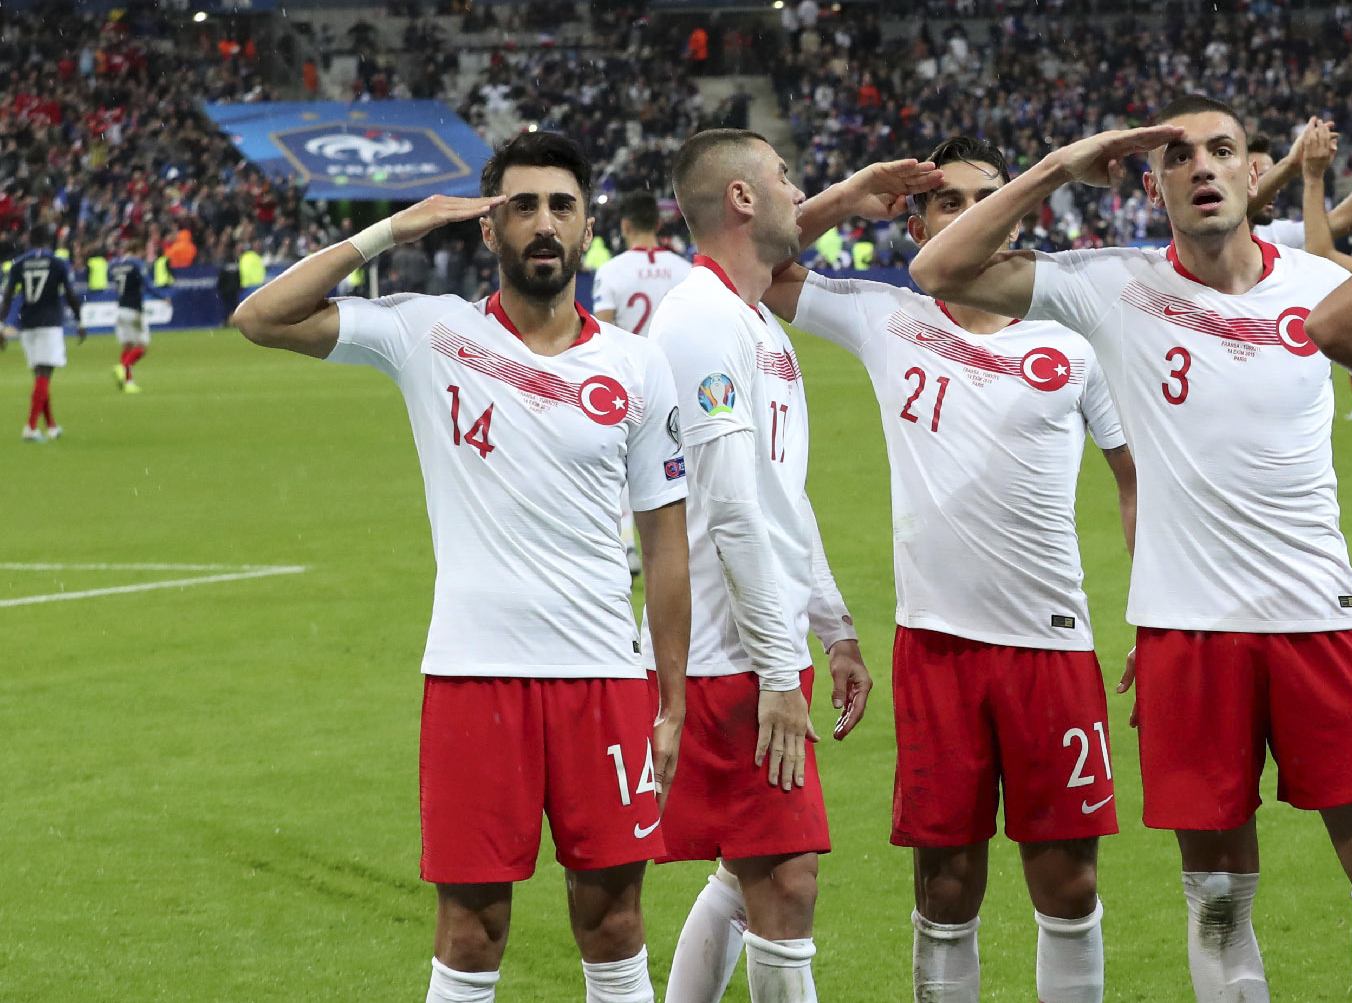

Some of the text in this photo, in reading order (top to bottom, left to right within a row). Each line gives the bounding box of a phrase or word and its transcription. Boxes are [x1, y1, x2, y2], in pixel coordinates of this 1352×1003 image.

[23, 269, 50, 304] 17
[626, 291, 652, 335] 2
[899, 365, 951, 433] 21
[1161, 346, 1192, 406] 3
[446, 384, 496, 459] 14
[770, 400, 789, 463] 17
[606, 735, 657, 806] 14
[1062, 720, 1112, 789] 21
